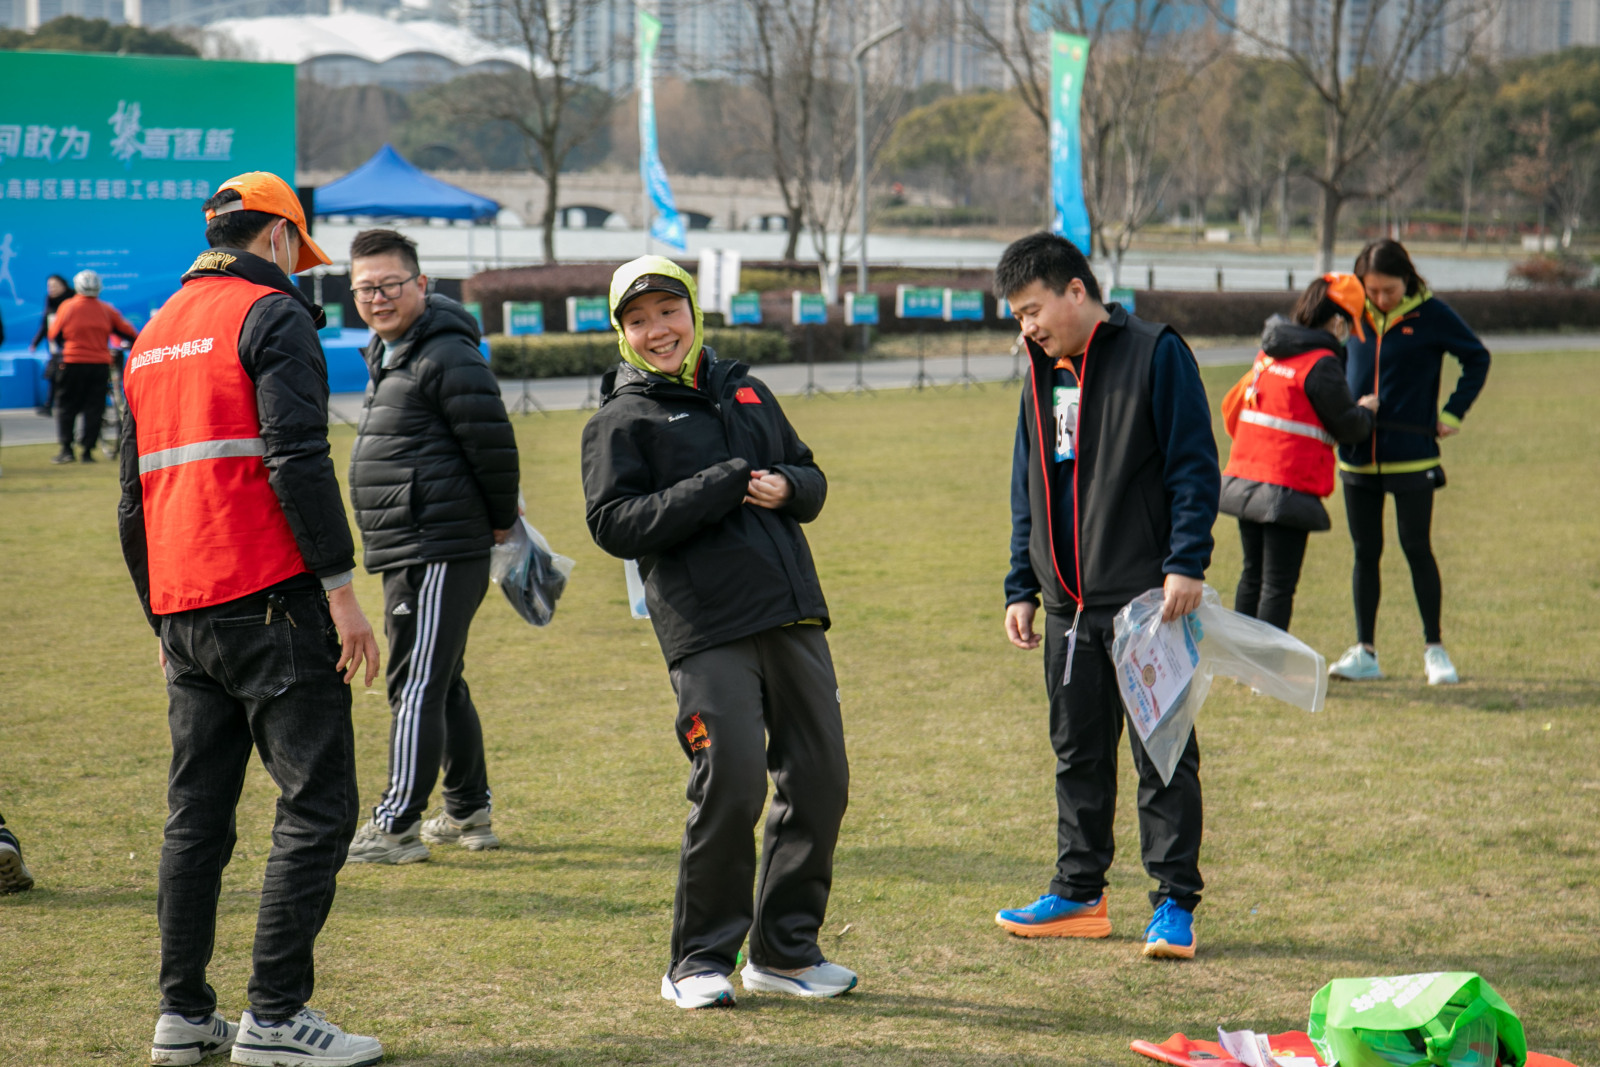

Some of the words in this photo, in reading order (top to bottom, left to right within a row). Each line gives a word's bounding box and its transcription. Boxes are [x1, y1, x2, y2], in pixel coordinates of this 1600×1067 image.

[0, 179, 210, 200] 高新区第五届职工长跑活动
